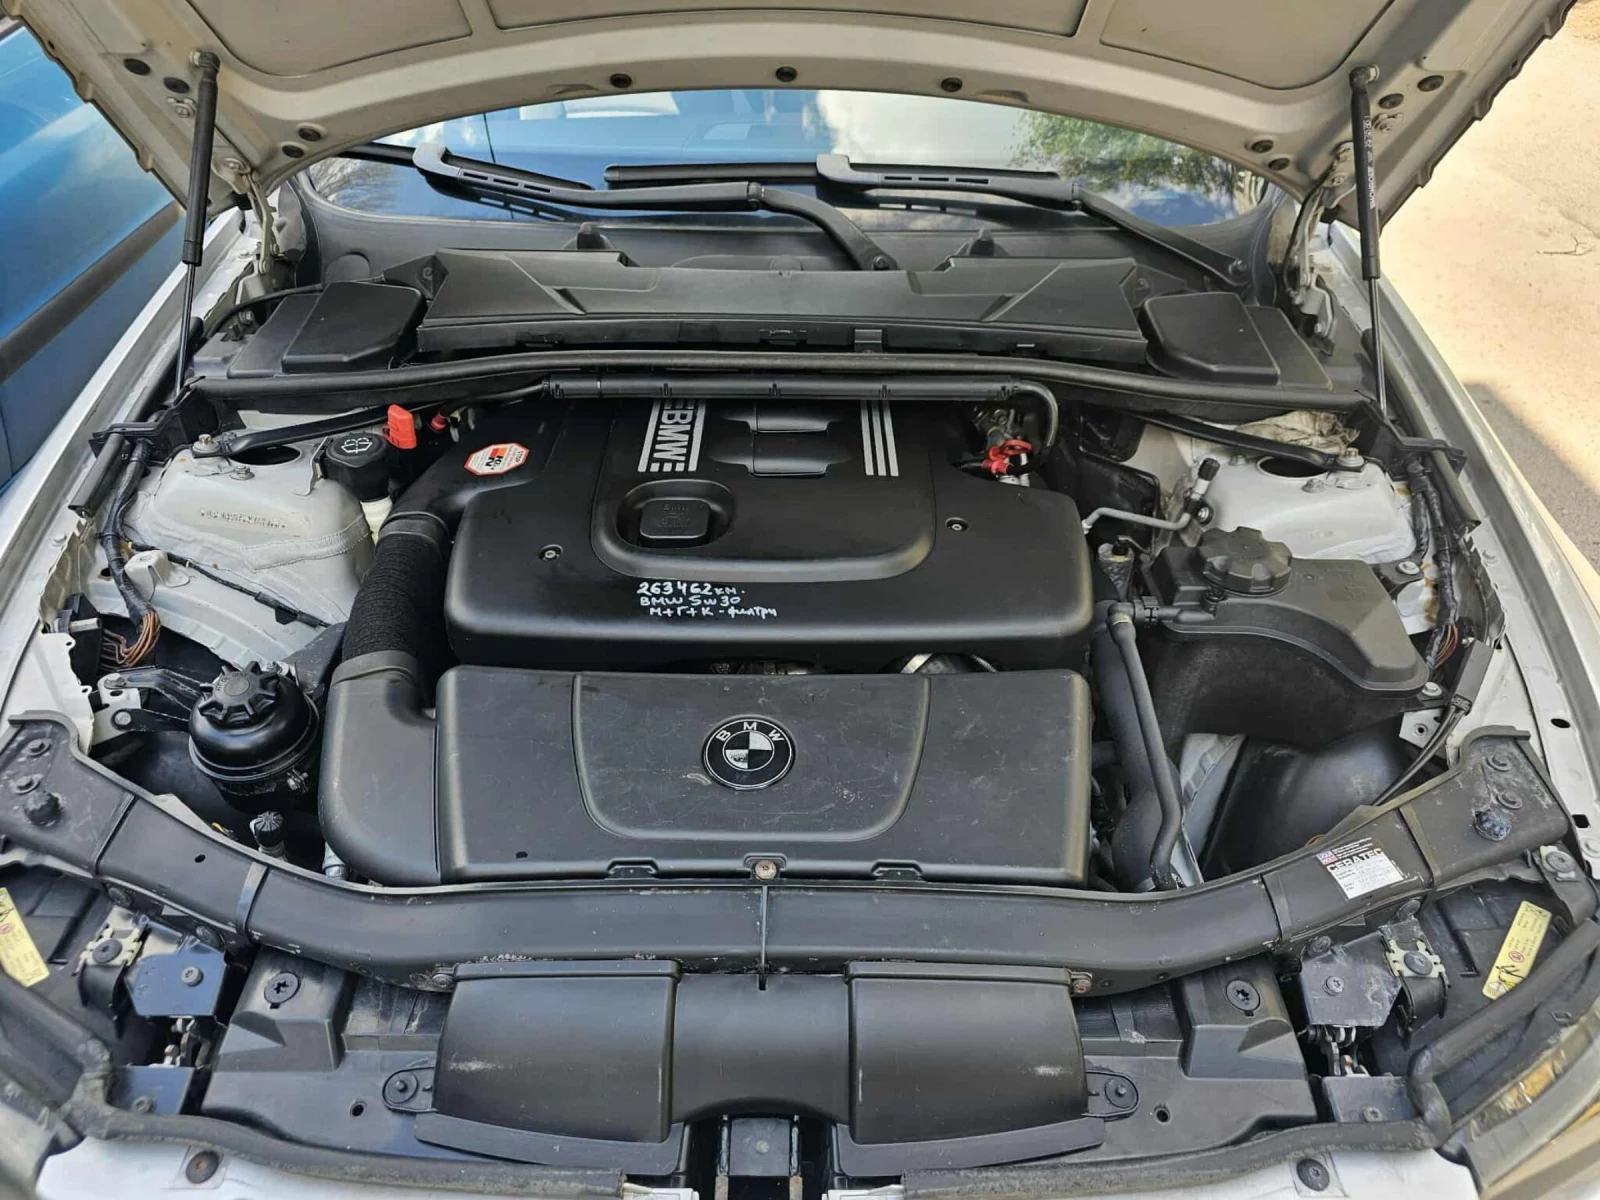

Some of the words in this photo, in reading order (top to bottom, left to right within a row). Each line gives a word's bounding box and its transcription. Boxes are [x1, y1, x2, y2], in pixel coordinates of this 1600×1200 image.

[653, 409, 694, 461] BMW
[640, 596, 683, 606] BMW
[715, 721, 785, 742] BMW
